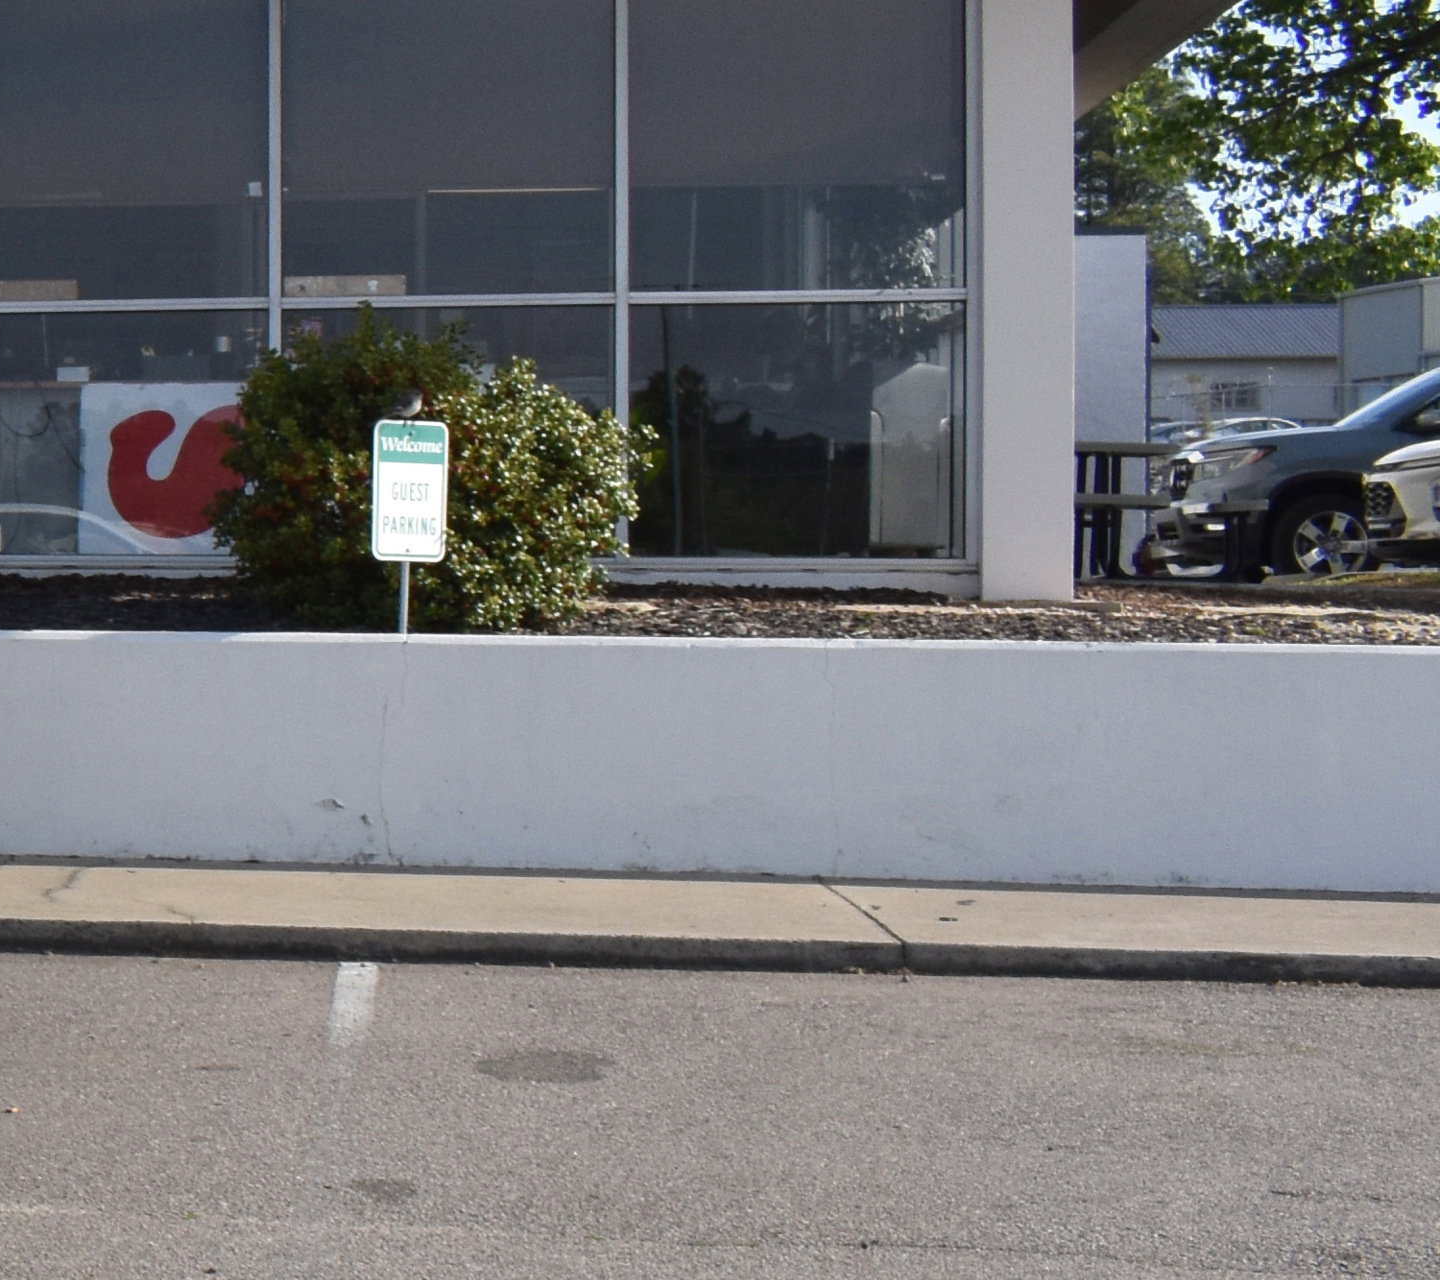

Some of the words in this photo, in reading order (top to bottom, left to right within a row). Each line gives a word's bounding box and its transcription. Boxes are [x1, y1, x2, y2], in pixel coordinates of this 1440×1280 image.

[380, 436, 443, 453] Welcome
[390, 482, 430, 502] GUEST
[382, 515, 437, 536] PARKING
